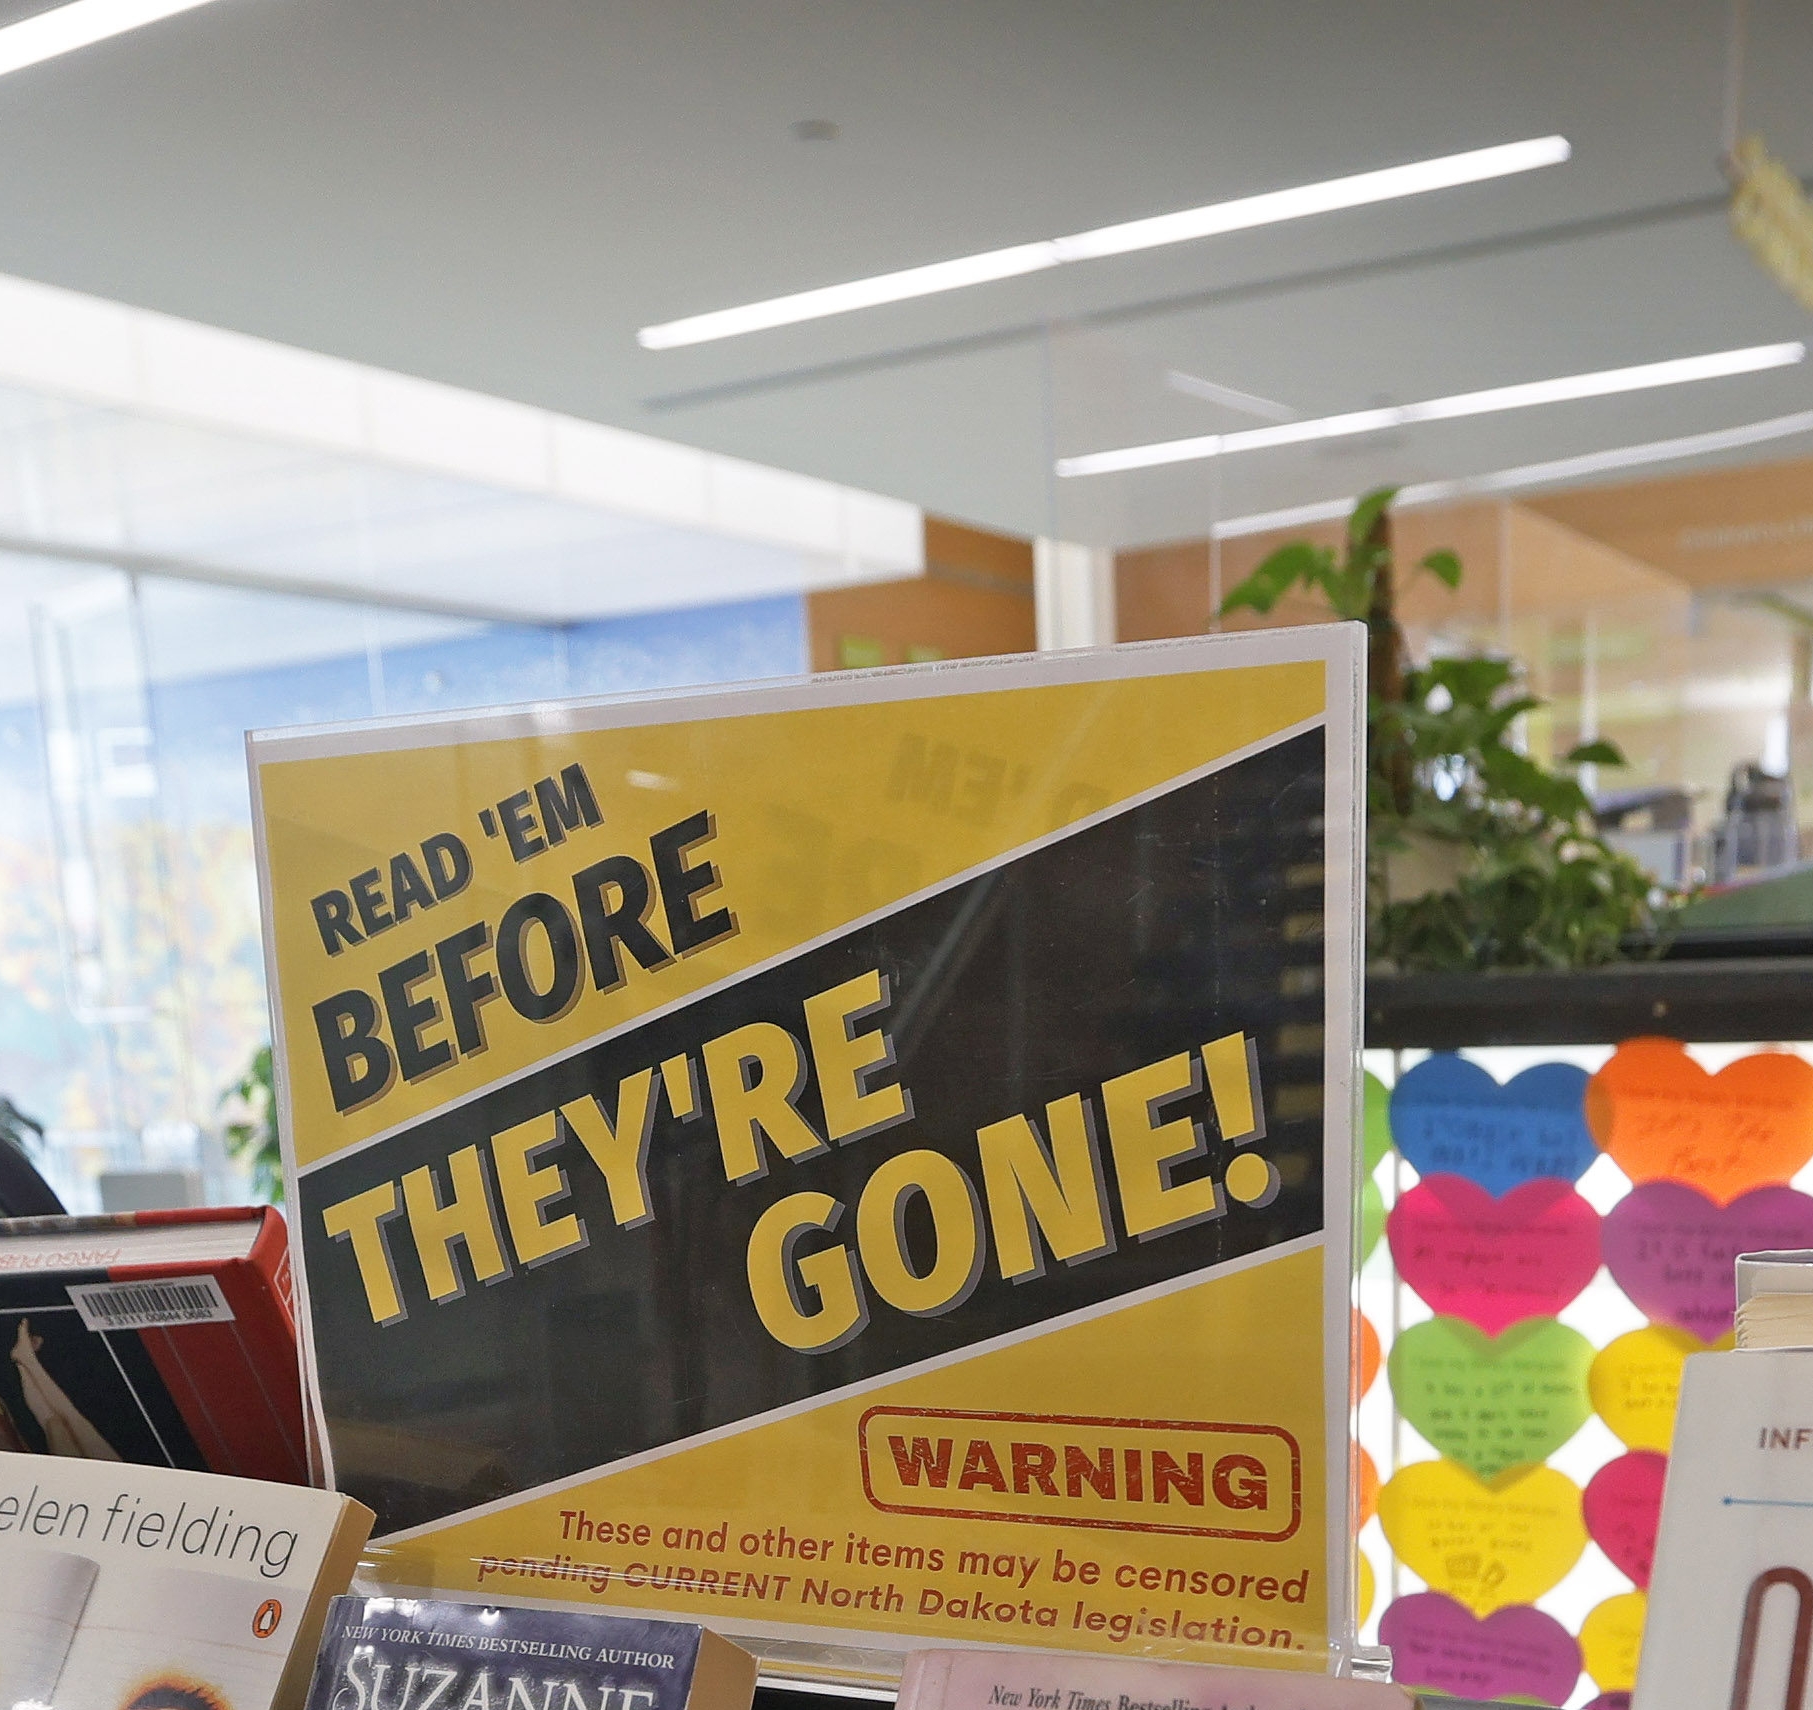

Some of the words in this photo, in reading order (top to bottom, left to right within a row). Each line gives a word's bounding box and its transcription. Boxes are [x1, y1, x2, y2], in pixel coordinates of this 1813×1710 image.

[310, 832, 474, 957] READ
[478, 763, 604, 863] 'EM
[312, 808, 740, 1117] BEFORE
[322, 968, 916, 1327] THEY'RE
[746, 1031, 1281, 1354] GONE!
[887, 1434, 1271, 1511] WARNING
[102, 1493, 299, 1579] fielding
[558, 1510, 651, 1548] These
[661, 1516, 728, 1554] and
[737, 1523, 833, 1564] other
[844, 1531, 945, 1573] items
[957, 1546, 1040, 1586] may
[1053, 1546, 1101, 1589] be
[1114, 1558, 1308, 1606] censored
[340, 1624, 381, 1643] NEW
[381, 1627, 422, 1647] YORK
[426, 1630, 475, 1651] TIMES
[477, 1635, 593, 1663] BESTSELLING
[595, 1646, 676, 1671] AUTHOR
[477, 1553, 612, 1596] pending
[622, 1561, 791, 1602] CURRENT
[800, 1576, 904, 1614] North
[917, 1586, 1060, 1631] Dakota
[1072, 1598, 1306, 1652] legislation.
[988, 1685, 1022, 1707] New
[1028, 1687, 1061, 1710] York
